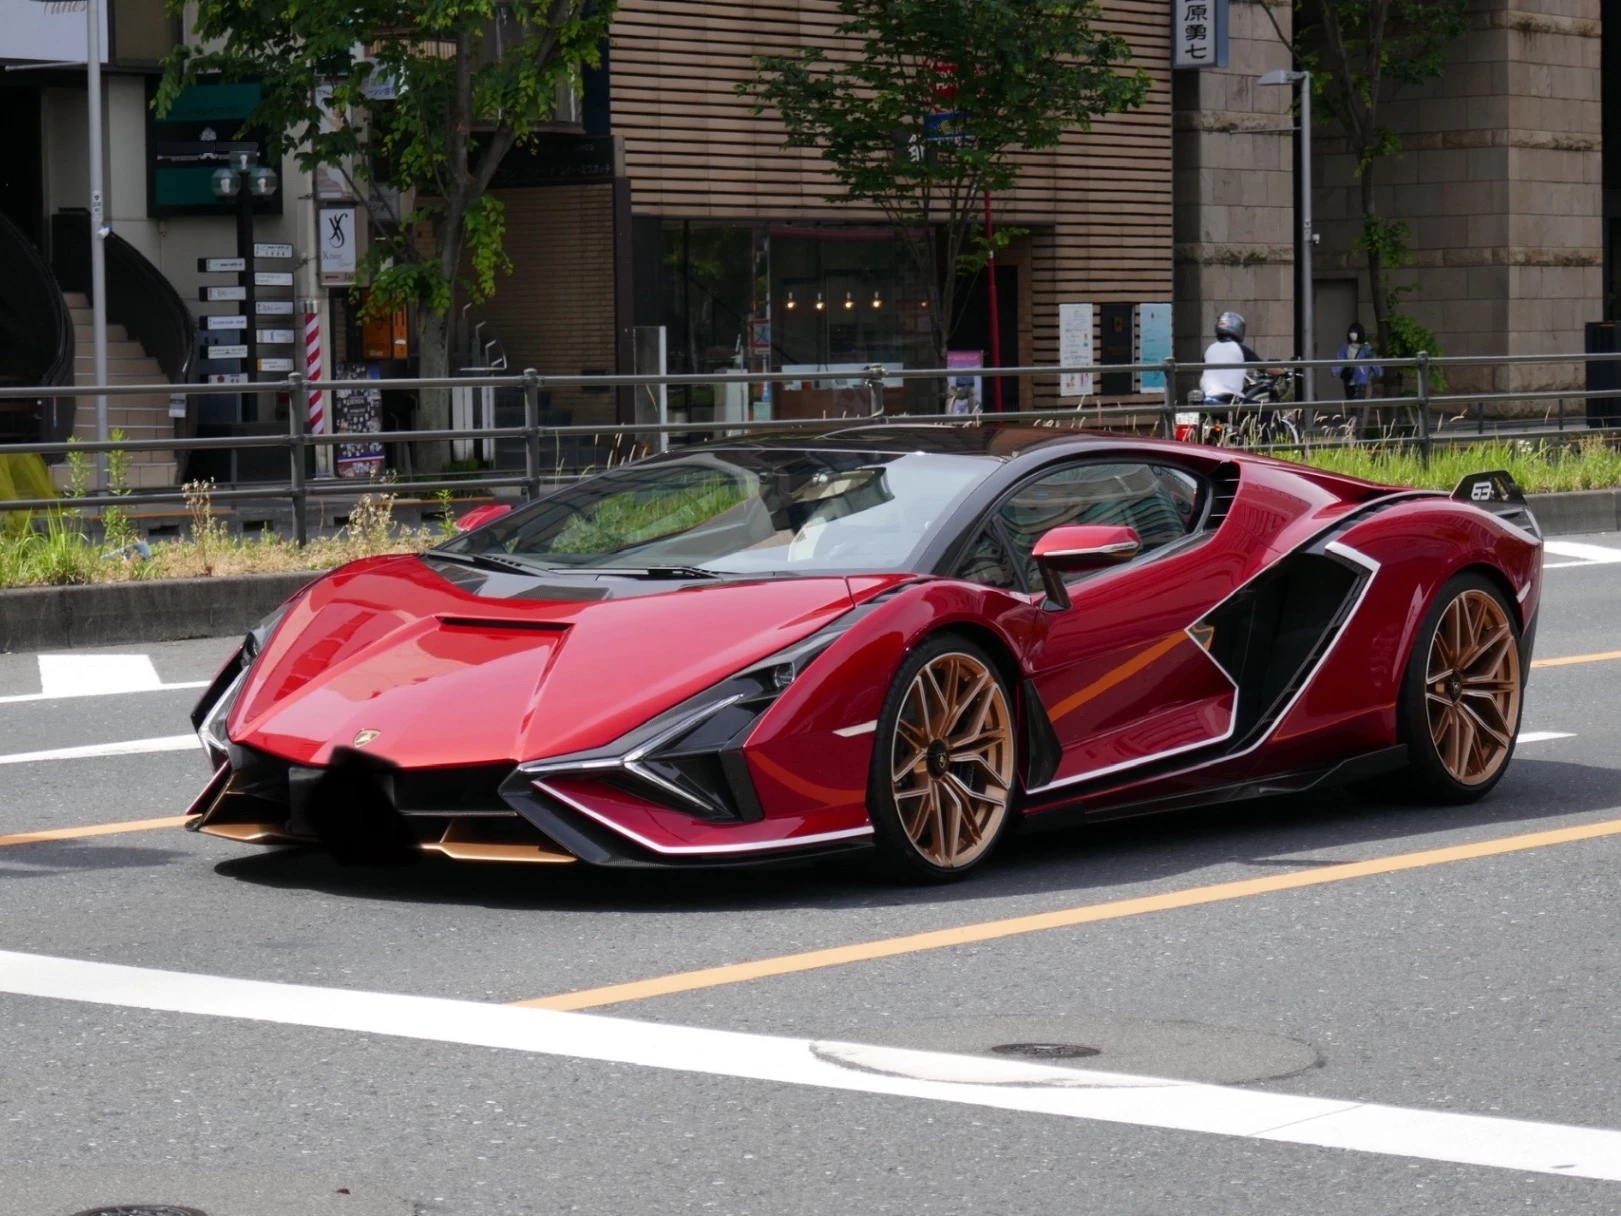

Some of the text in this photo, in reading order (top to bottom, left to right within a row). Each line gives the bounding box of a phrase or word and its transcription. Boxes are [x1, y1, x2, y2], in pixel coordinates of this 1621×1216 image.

[1184, 0, 1207, 60] 原勇七
[1471, 481, 1492, 501] 63
